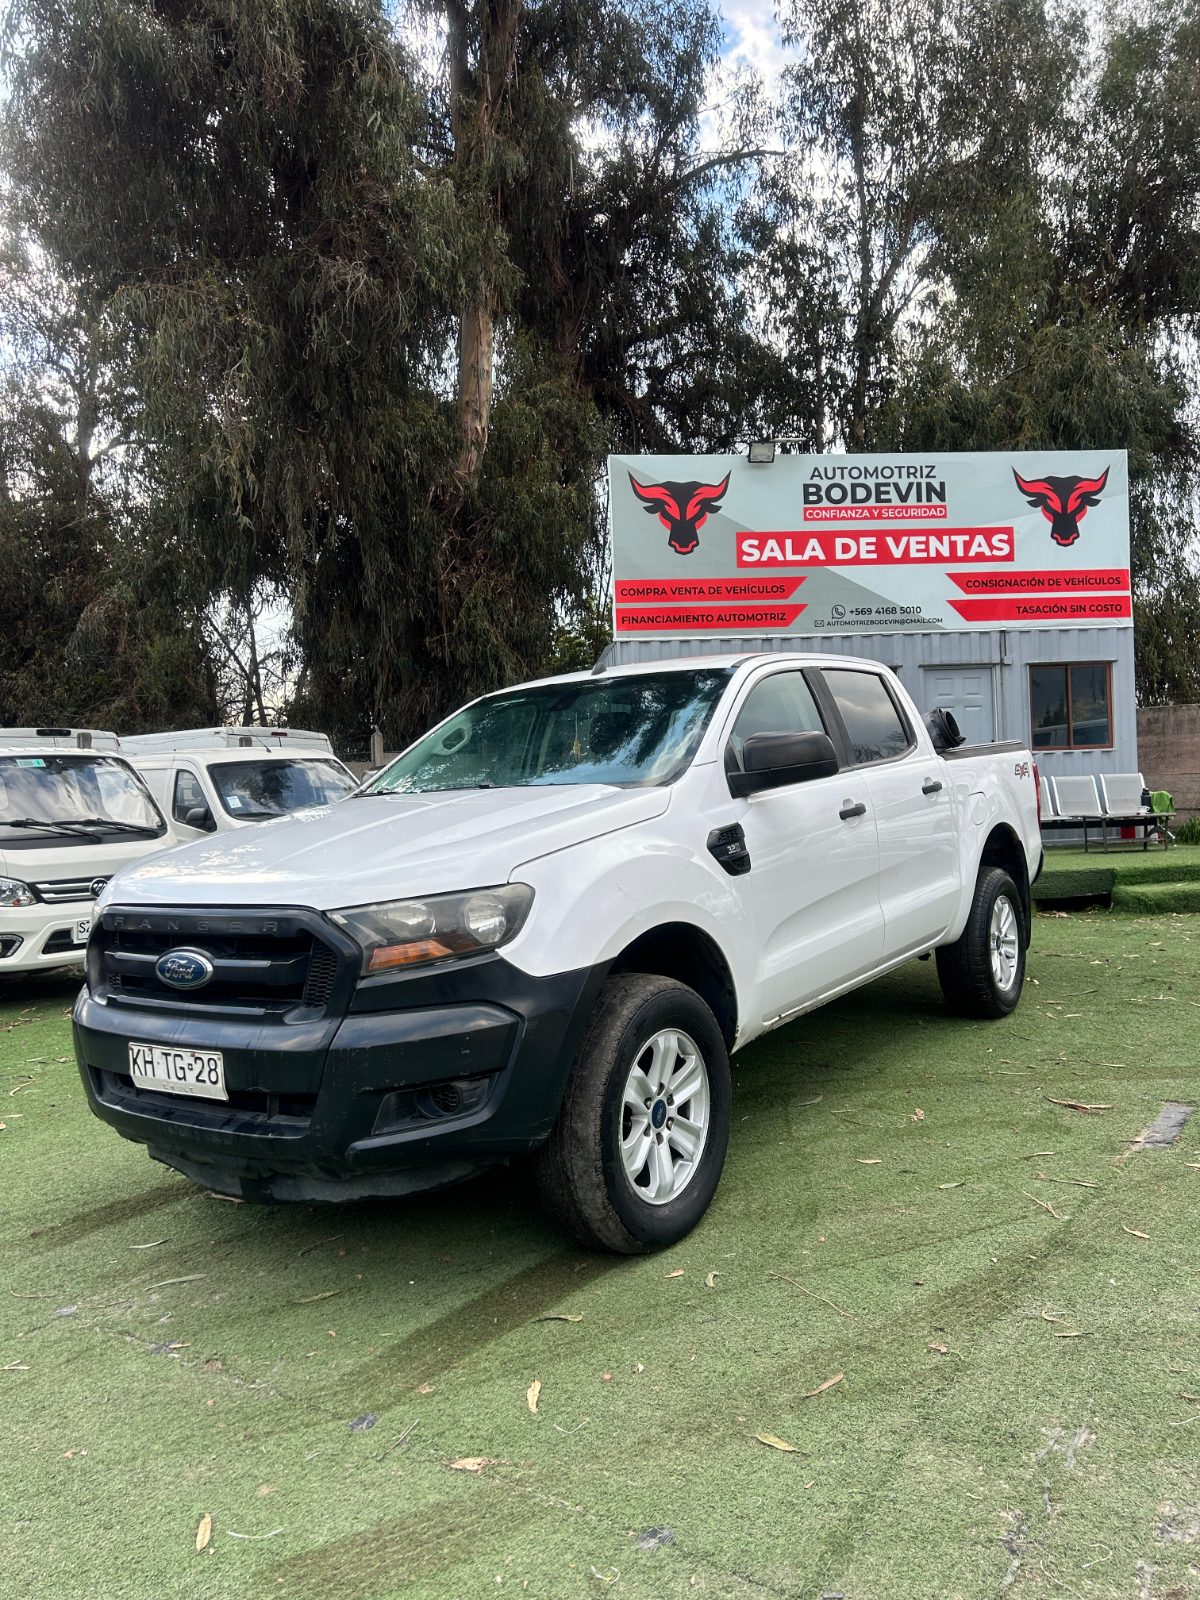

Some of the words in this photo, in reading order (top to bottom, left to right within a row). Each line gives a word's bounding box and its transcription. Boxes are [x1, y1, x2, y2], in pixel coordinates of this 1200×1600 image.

[810, 466, 936, 480] AUTOMOTRIZ
[803, 482, 946, 504] BODEVIN
[806, 509, 870, 518] CONFIANZA
[872, 509, 879, 518] Y
[881, 508, 946, 518] SEGURIDAD
[741, 538, 826, 562] SALA
[835, 536, 878, 560] DE
[884, 534, 1010, 558] VENTAS
[966, 577, 1044, 588] CONSIGNACIÓN
[1048, 578, 1062, 586] DE
[1063, 576, 1121, 586] VEHÍCULOS
[620, 587, 667, 596] COMPRA
[670, 586, 705, 596] VENTA
[708, 586, 722, 595] DE
[725, 584, 786, 594] VEHÍCULOS
[849, 607, 872, 616] +569
[874, 606, 898, 615] 4168
[899, 606, 922, 614] 5010
[1016, 603, 1068, 614] TASACIÓN
[1070, 604, 1087, 613] SIN
[1088, 603, 1122, 612] COSTO
[622, 614, 714, 624] FINANCIAMIENTO
[716, 612, 786, 622] AUTOMOTRIZ
[114, 916, 278, 932] RANGER
[164, 958, 196, 980] Ford
